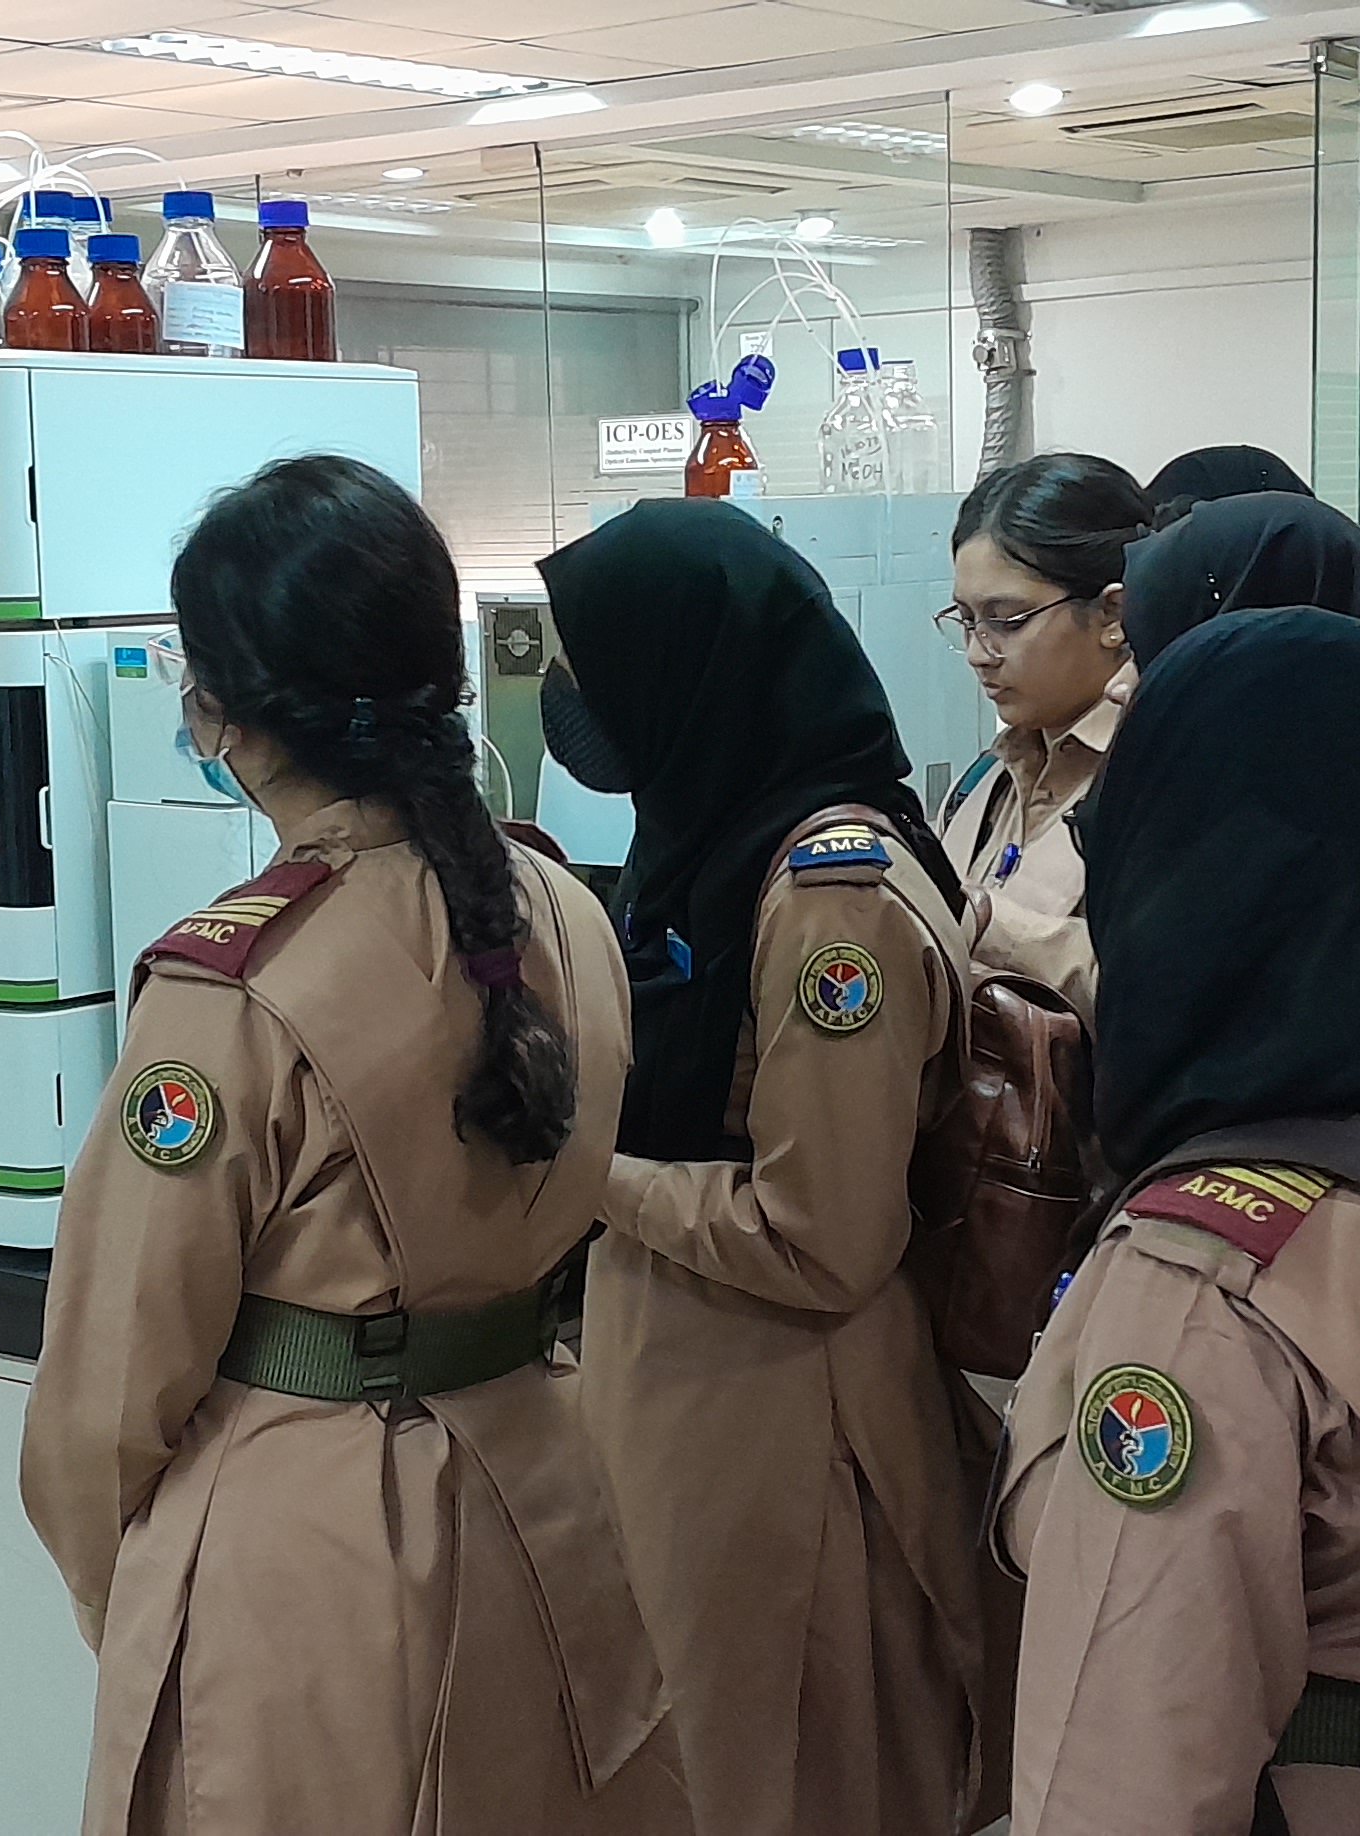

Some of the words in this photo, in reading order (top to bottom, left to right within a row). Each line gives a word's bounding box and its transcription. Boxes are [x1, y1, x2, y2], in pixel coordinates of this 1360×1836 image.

[605, 421, 685, 443] ICP-OES
[810, 838, 872, 856] AMC
[1175, 1174, 1276, 1223] AFMC
[1093, 1460, 1163, 1496] AFMC
